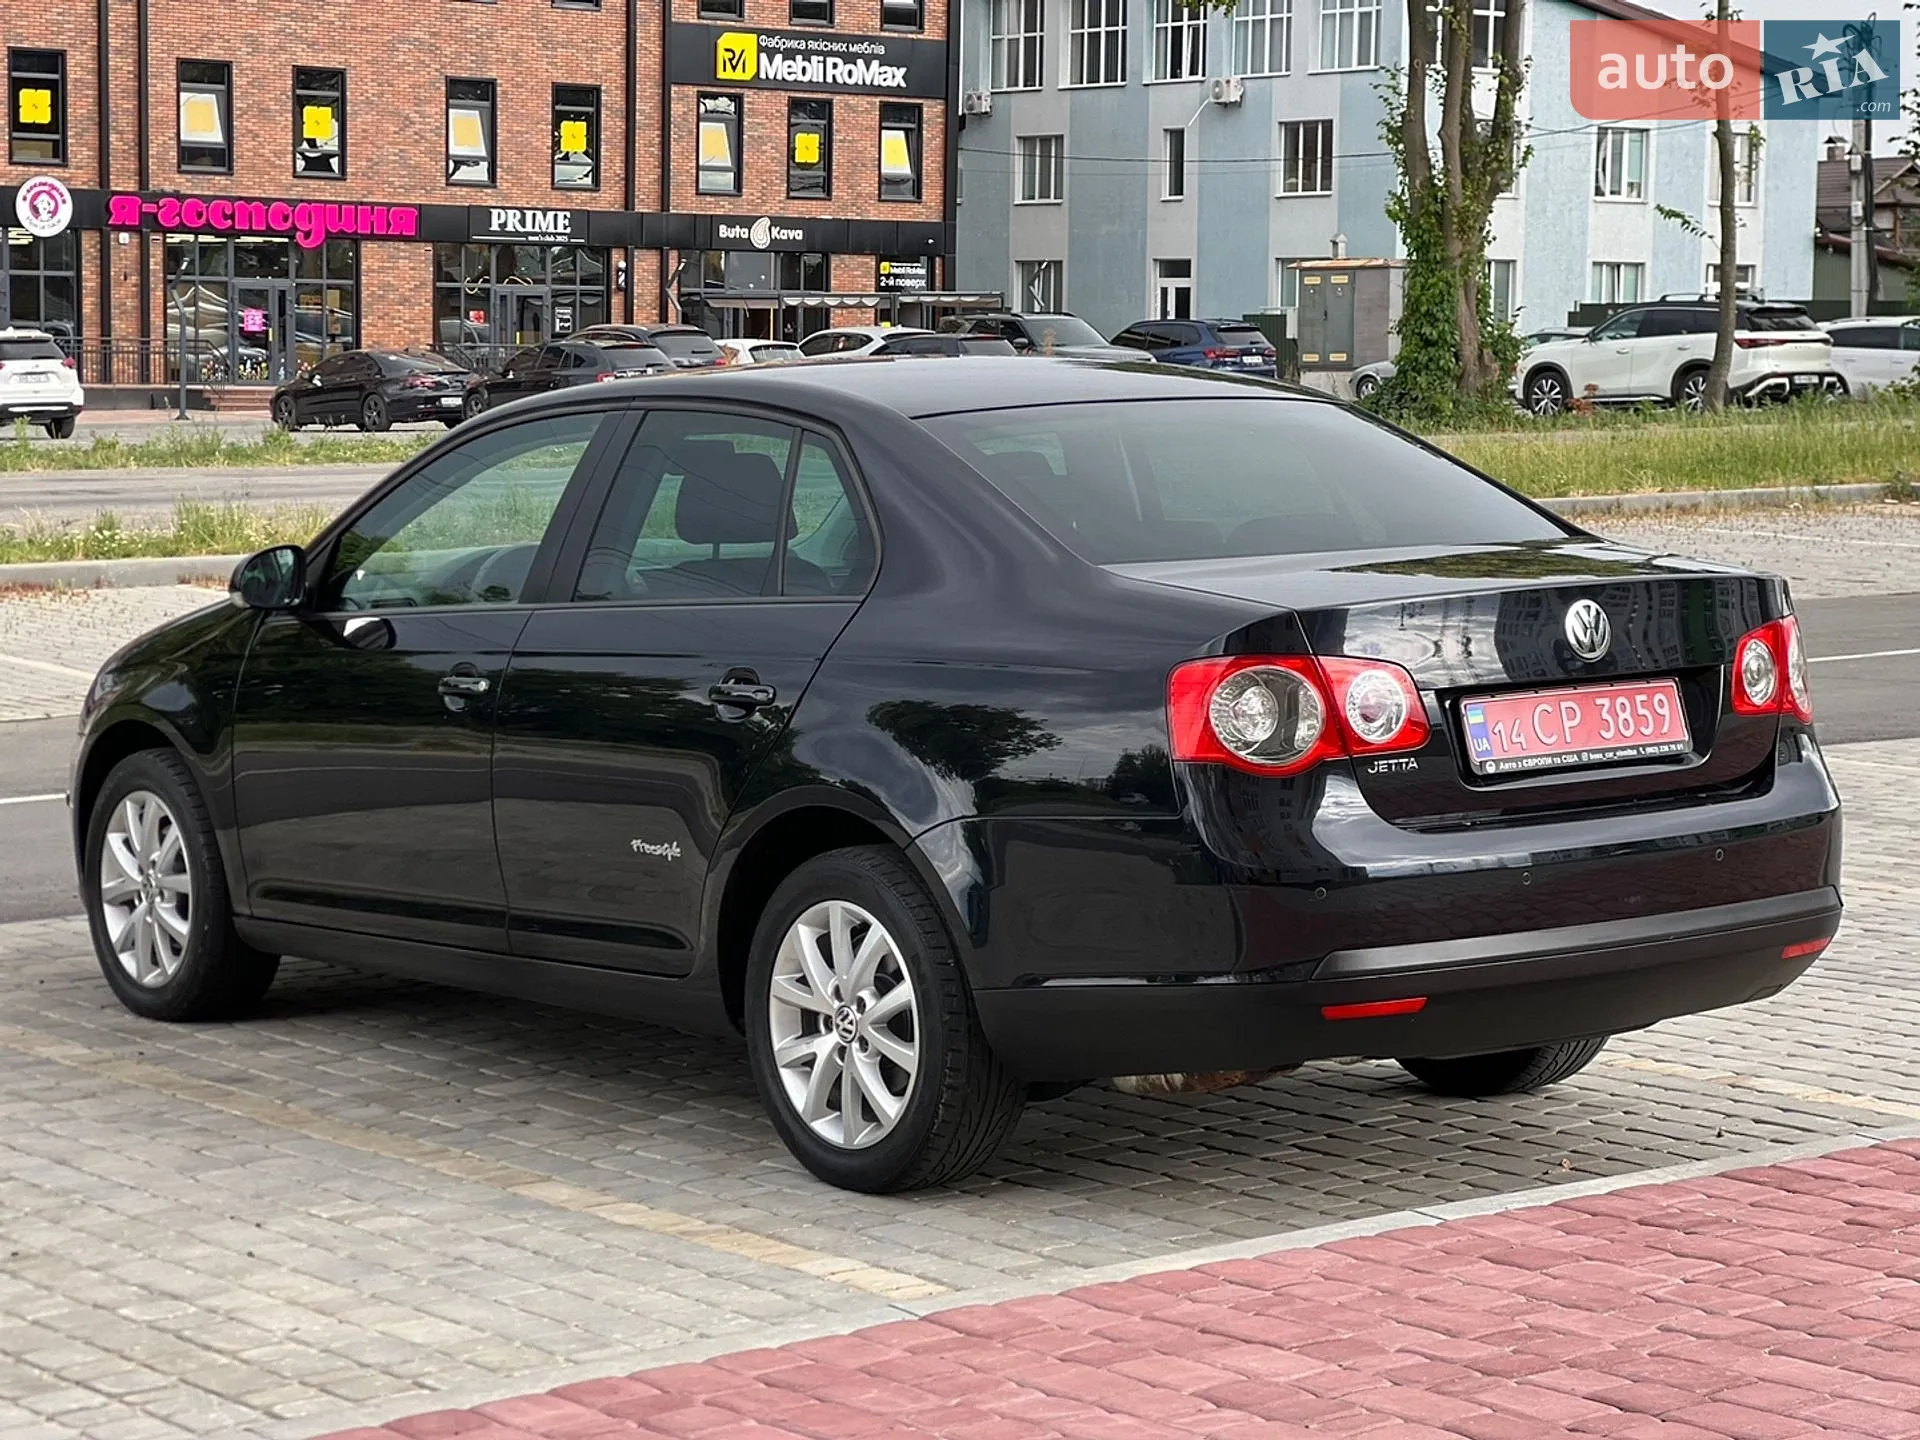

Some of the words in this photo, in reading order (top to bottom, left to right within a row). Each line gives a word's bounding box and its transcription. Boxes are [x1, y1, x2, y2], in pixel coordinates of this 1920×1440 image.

[758, 35, 806, 50] Фабрика
[807, 38, 847, 53] якісних
[849, 41, 886, 55] меблів
[489, 208, 572, 234] PRIME
[718, 224, 749, 239] Buta
[771, 226, 804, 240] Kava
[1492, 718, 1527, 752] 14
[1595, 693, 1672, 740] 3859
[1474, 738, 1491, 752] UA
[1367, 757, 1419, 773] JETTA
